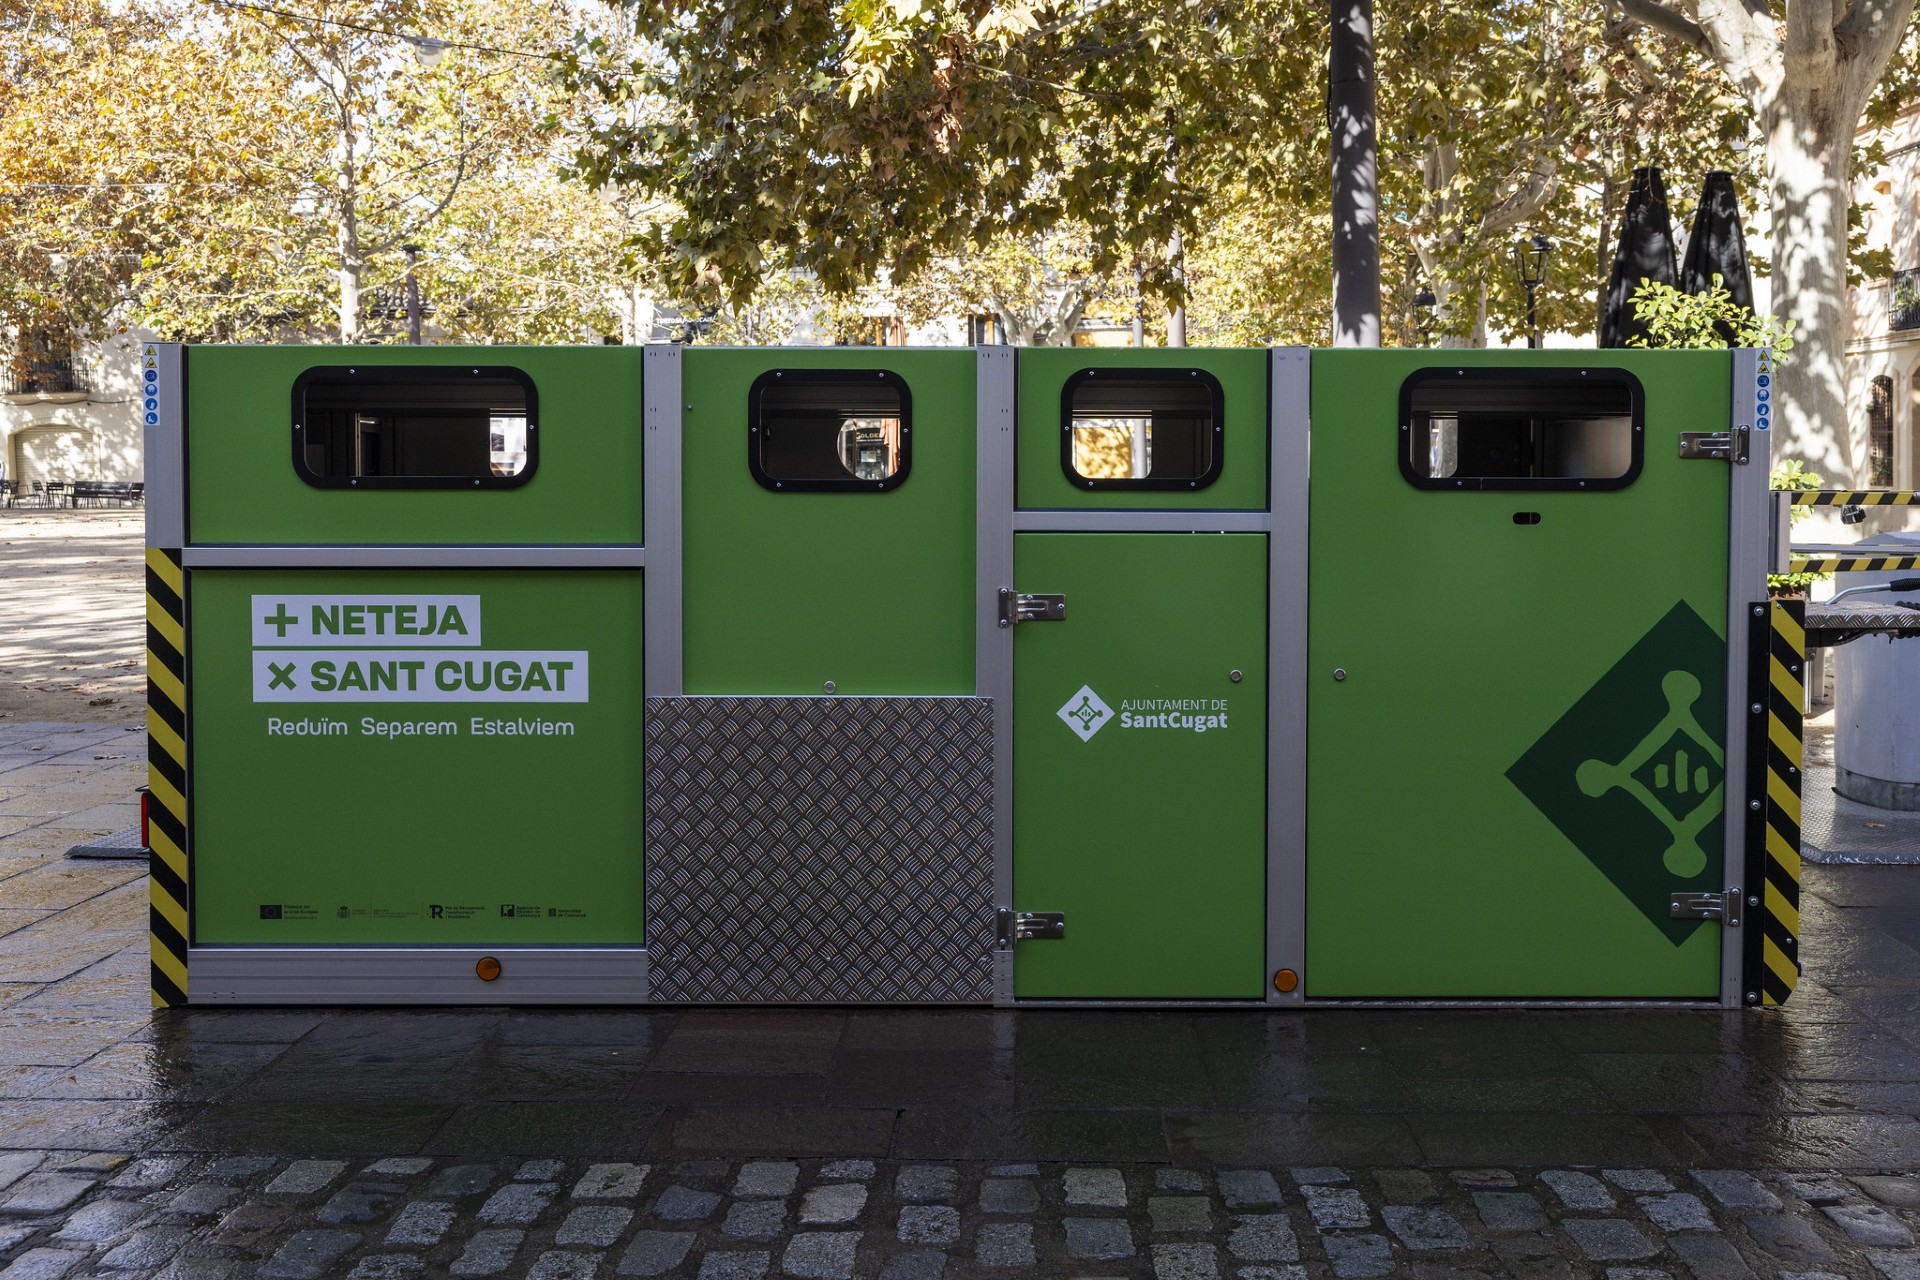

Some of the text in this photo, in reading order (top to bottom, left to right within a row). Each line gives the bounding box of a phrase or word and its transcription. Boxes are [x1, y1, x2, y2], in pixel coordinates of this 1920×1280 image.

[311, 605, 468, 636] NETEJA
[310, 660, 425, 692] SANT
[434, 660, 574, 692] CUGAT
[1120, 699, 1228, 711] AJUNTAMENT DE
[267, 716, 575, 740] Reduïm Separem Estalviem
[1120, 711, 1228, 733] SantCugat
